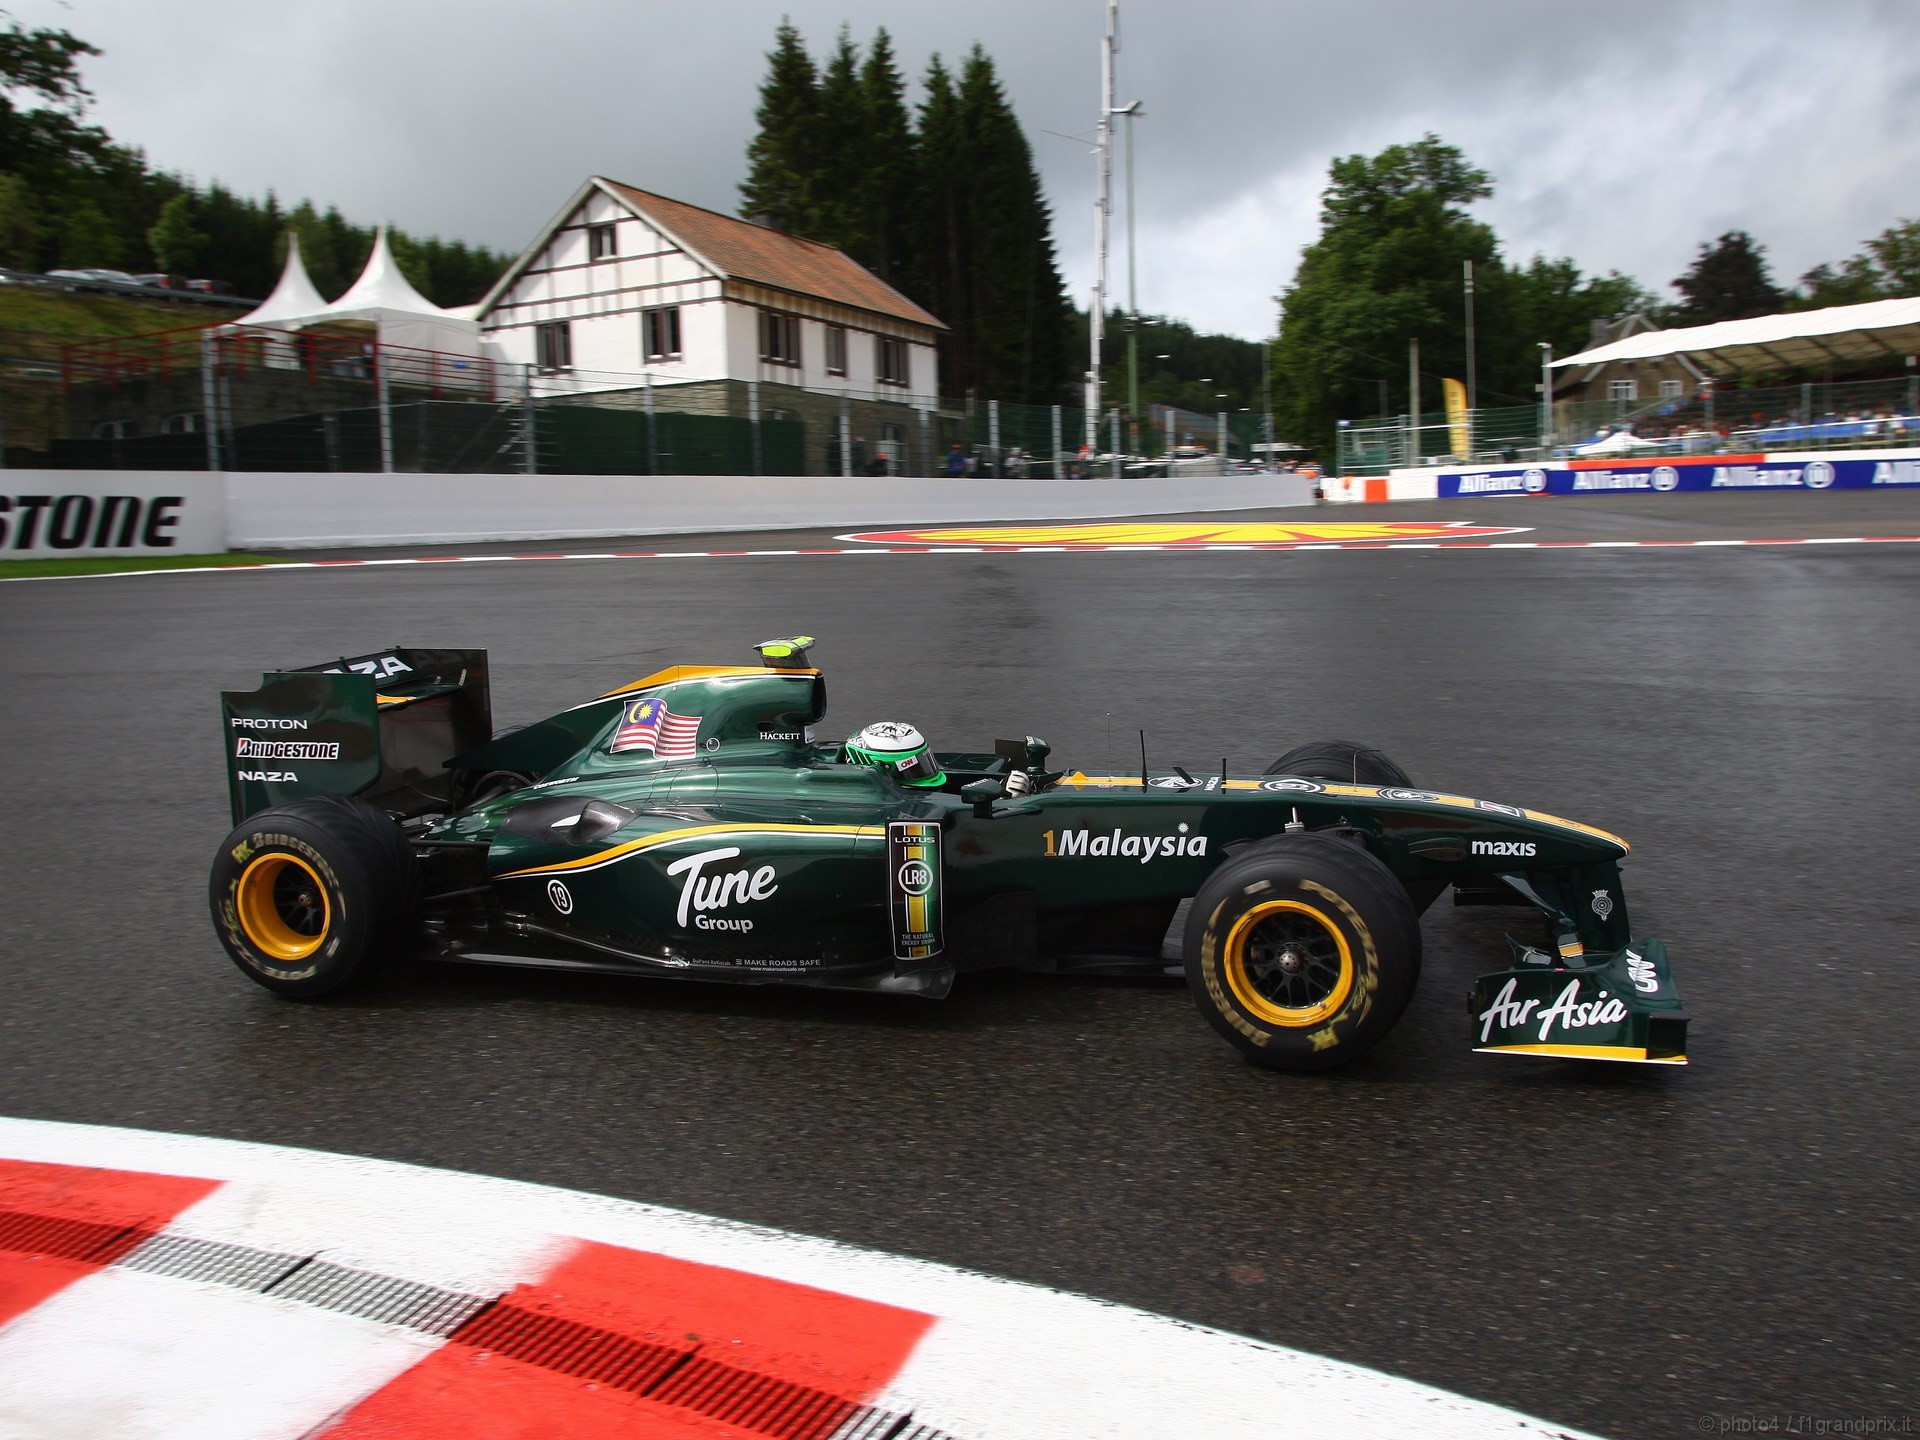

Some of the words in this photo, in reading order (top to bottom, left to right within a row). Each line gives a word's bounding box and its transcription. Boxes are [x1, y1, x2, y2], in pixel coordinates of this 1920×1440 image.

[1457, 474, 1524, 493] Allianz
[1572, 470, 1651, 490] Allianz
[1711, 465, 1804, 487] Allianz
[231, 718, 308, 730] PROTON
[760, 732, 800, 740] HACKETT
[236, 738, 340, 759] BRIDGESTONE
[900, 758, 915, 768] CNN
[238, 771, 298, 782] NAZA
[1471, 840, 1536, 856] maxis
[904, 869, 928, 885] LR8
[551, 886, 568, 908] 19
[666, 847, 779, 928] Tune
[695, 914, 754, 934] Group
[768, 959, 798, 967] ROADS
[1536, 977, 1628, 1042] Asia
